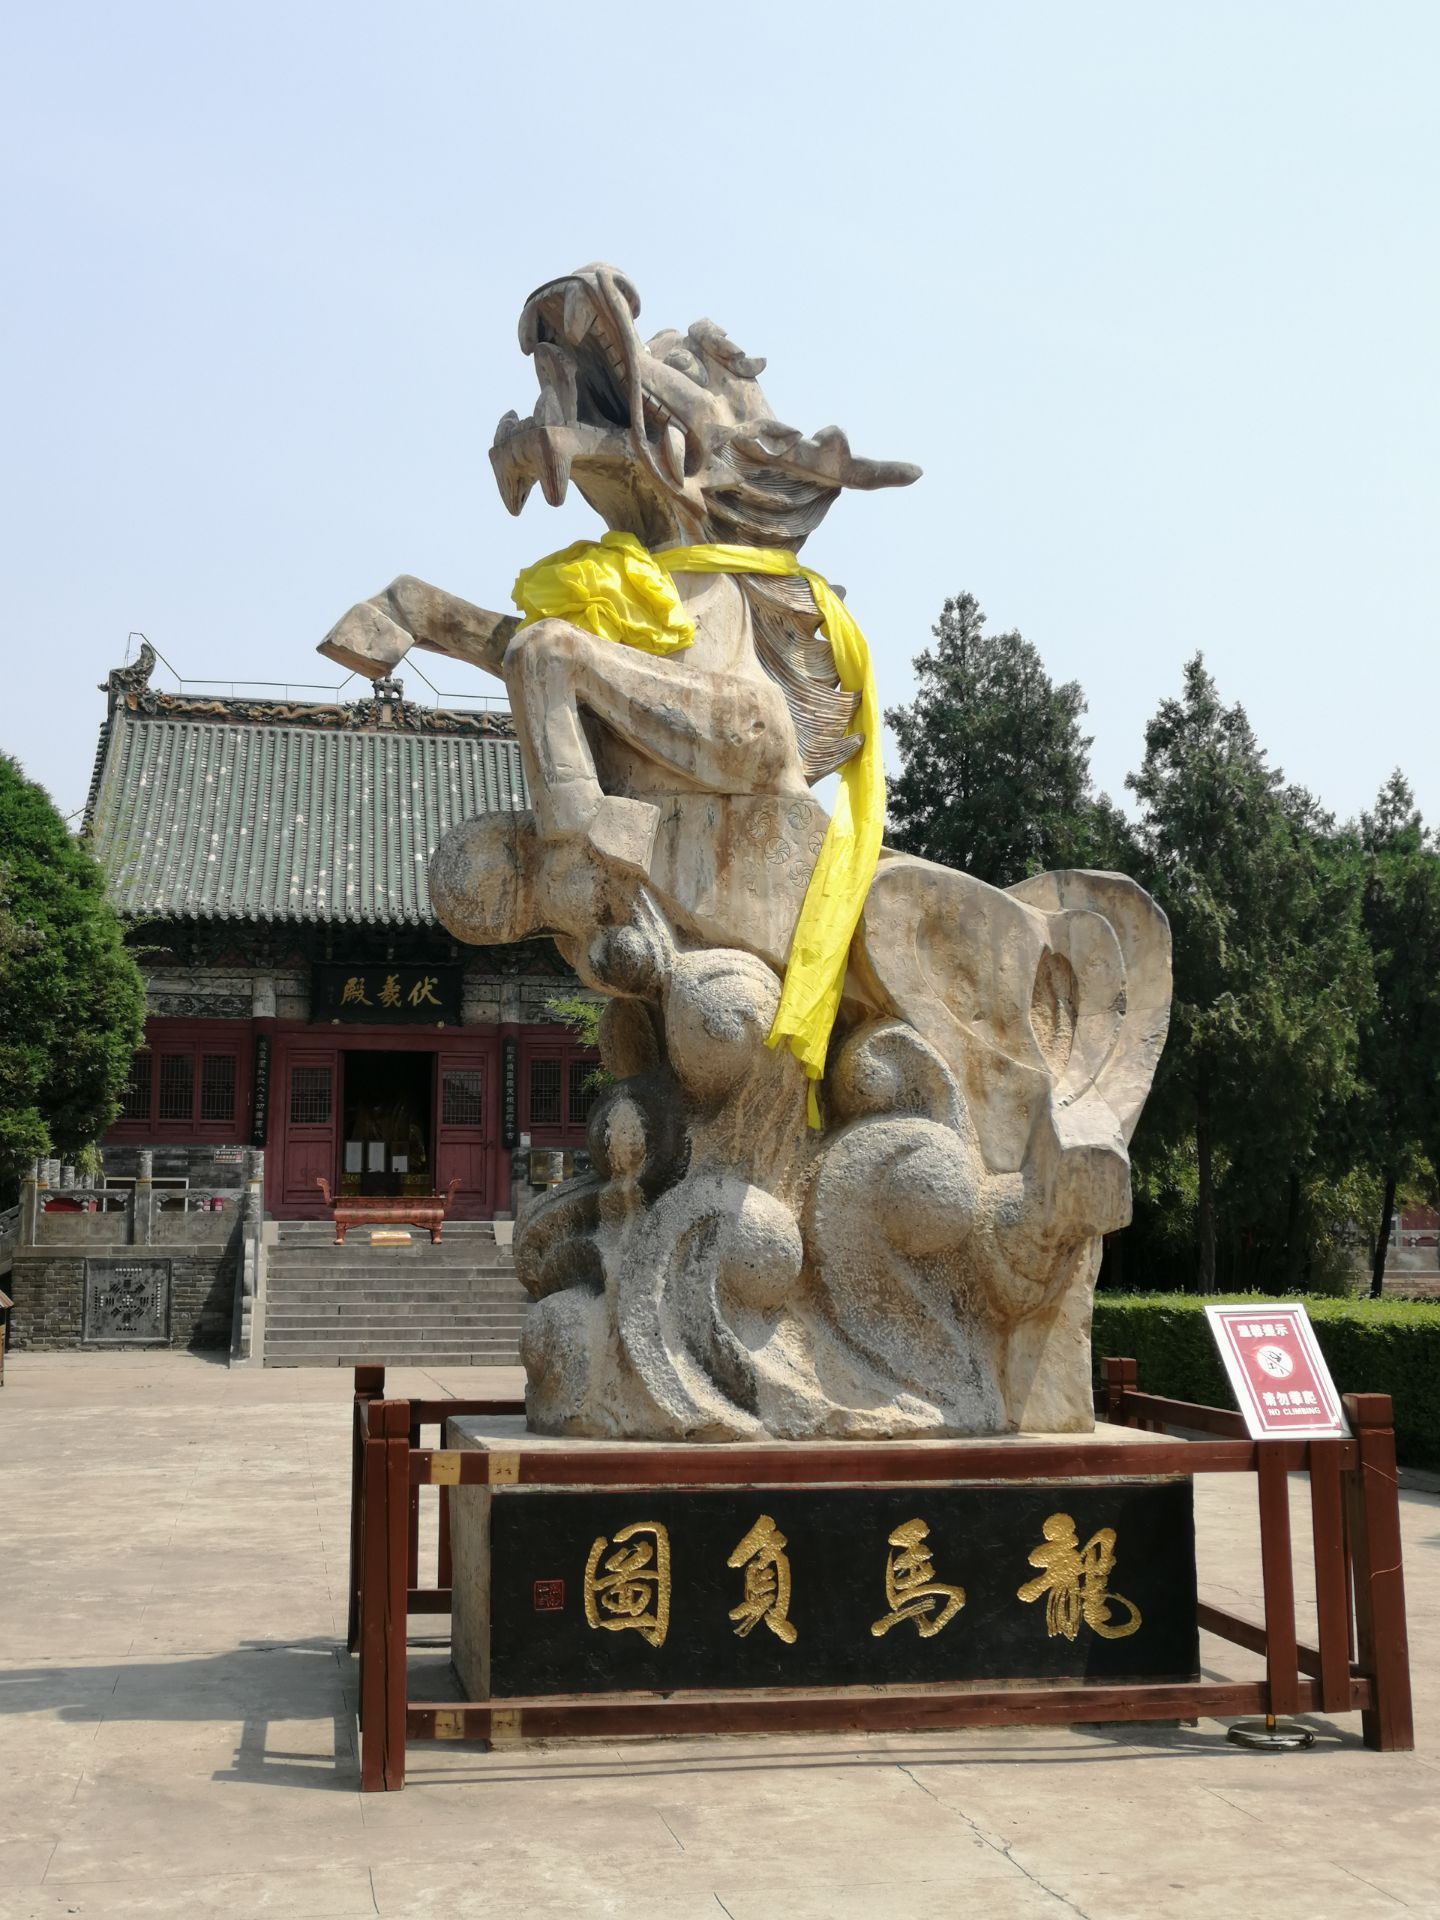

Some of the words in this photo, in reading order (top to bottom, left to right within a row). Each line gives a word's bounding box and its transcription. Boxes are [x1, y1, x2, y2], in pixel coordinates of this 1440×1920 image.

[1263, 1390, 1318, 1407] 请勿攀爬
[1268, 1408, 1280, 1416] NO
[1283, 1406, 1321, 1415] CLIMBING
